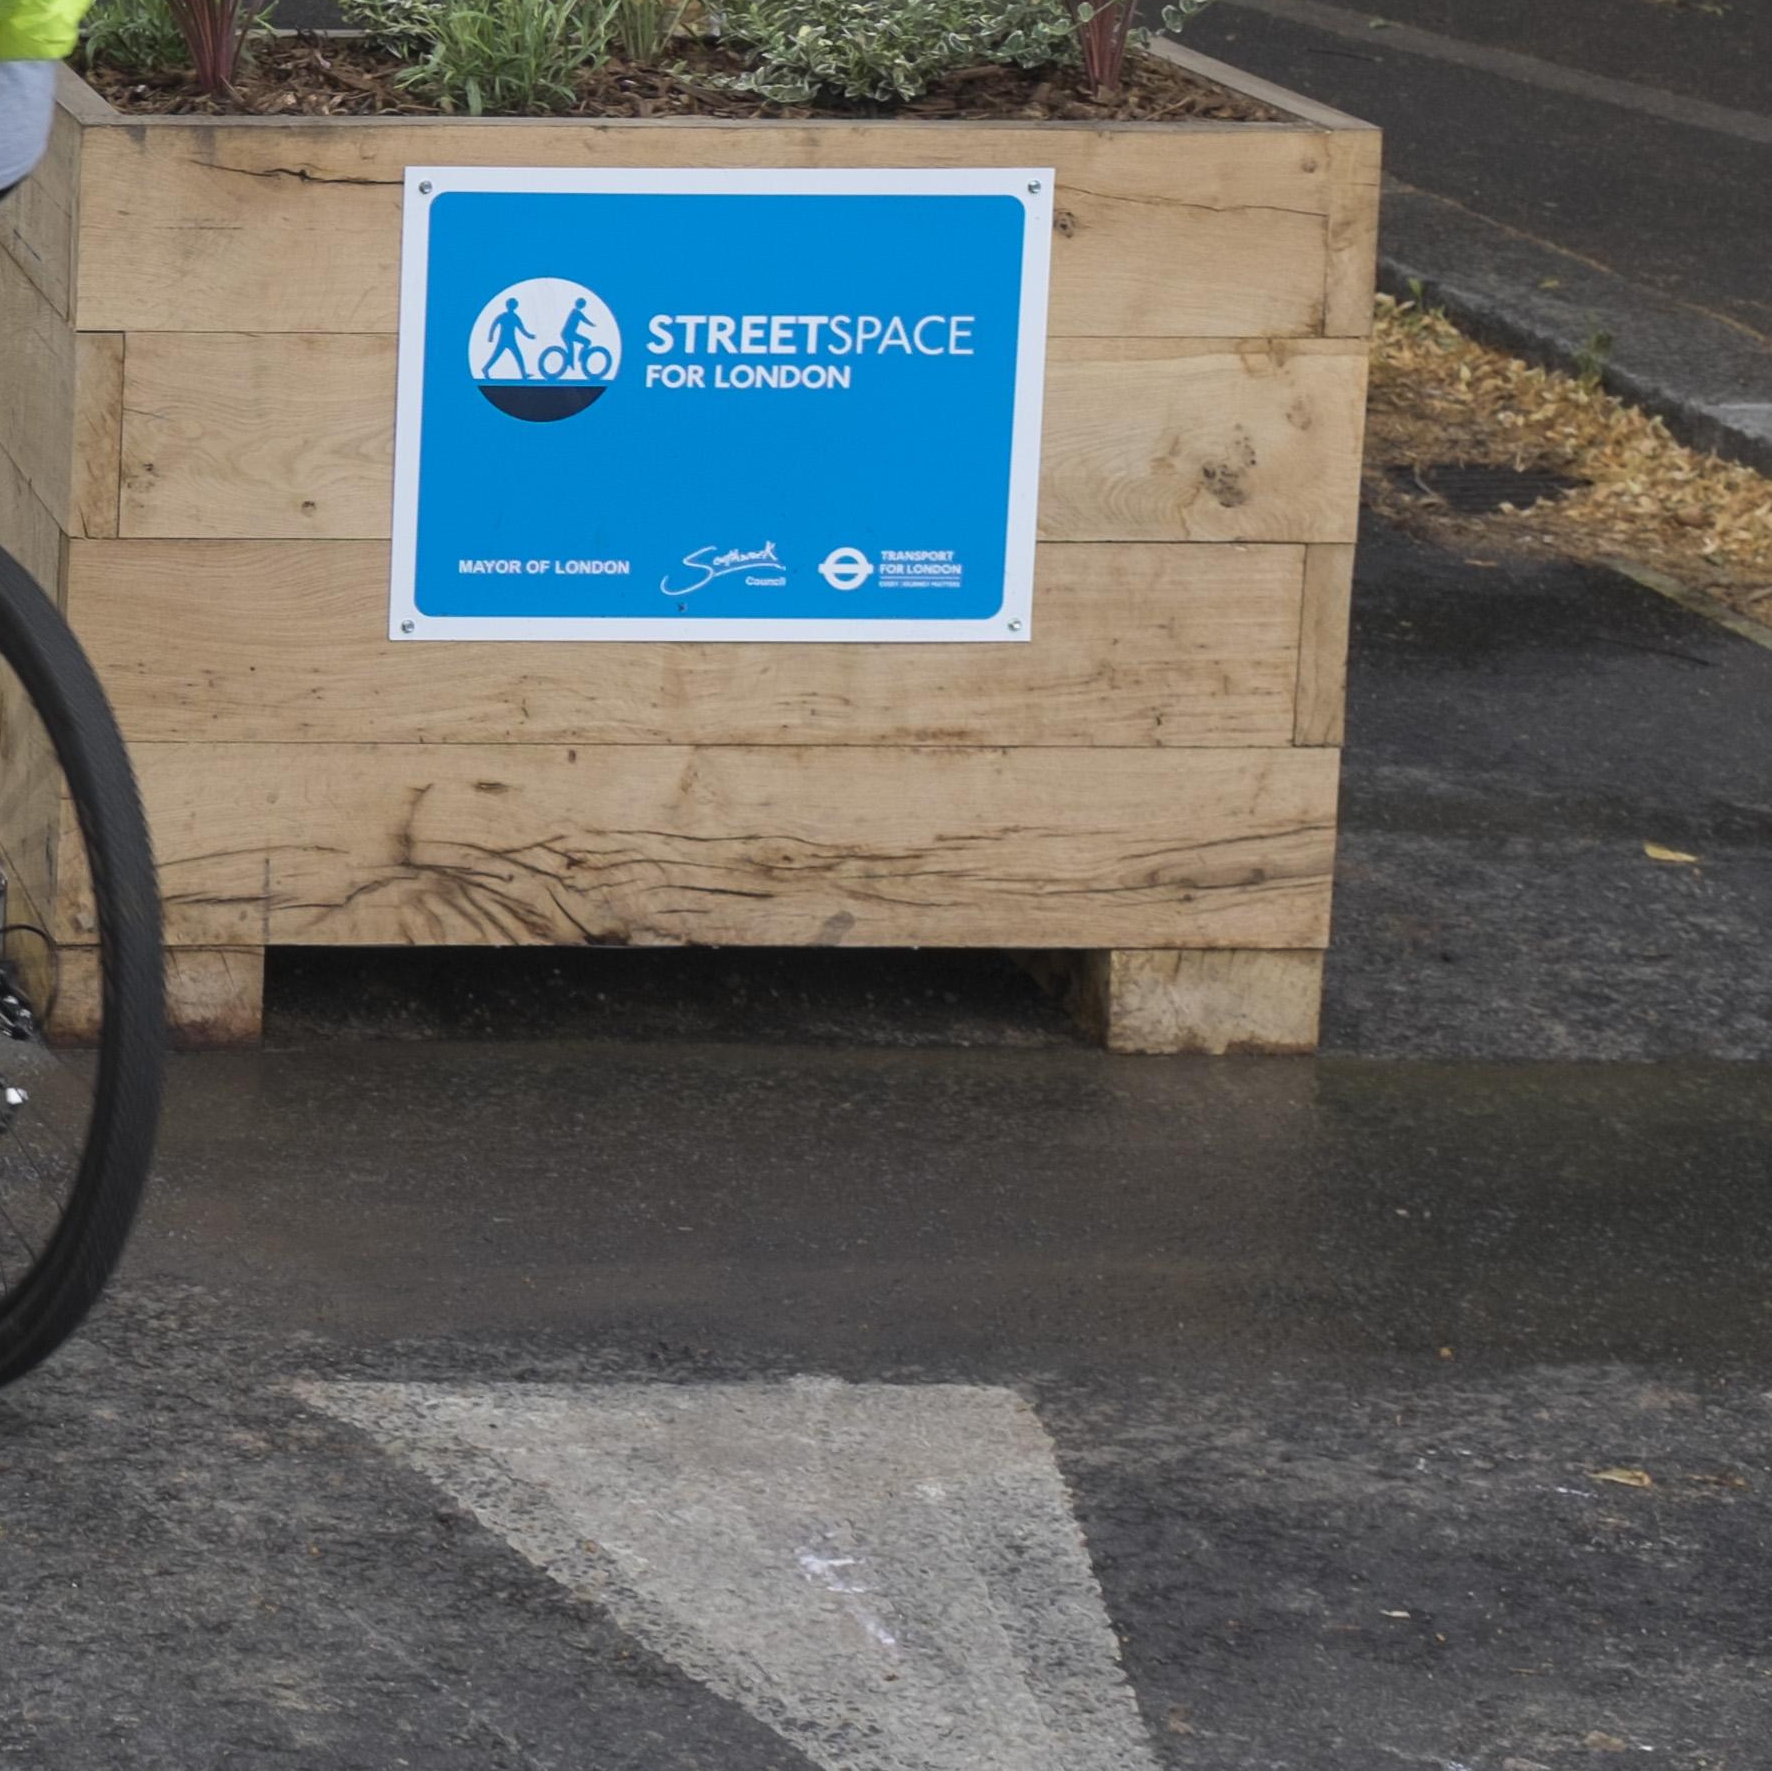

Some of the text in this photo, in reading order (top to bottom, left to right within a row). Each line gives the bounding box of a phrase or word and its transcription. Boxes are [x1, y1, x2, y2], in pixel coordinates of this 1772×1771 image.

[645, 314, 975, 356] STREETSPACE
[646, 364, 851, 389] FOR LONDON
[880, 550, 955, 562] TRANSPORT
[458, 559, 630, 575] MAYOR OF LONDON
[879, 563, 962, 575] FOR LONDON
[745, 576, 786, 587] Council
